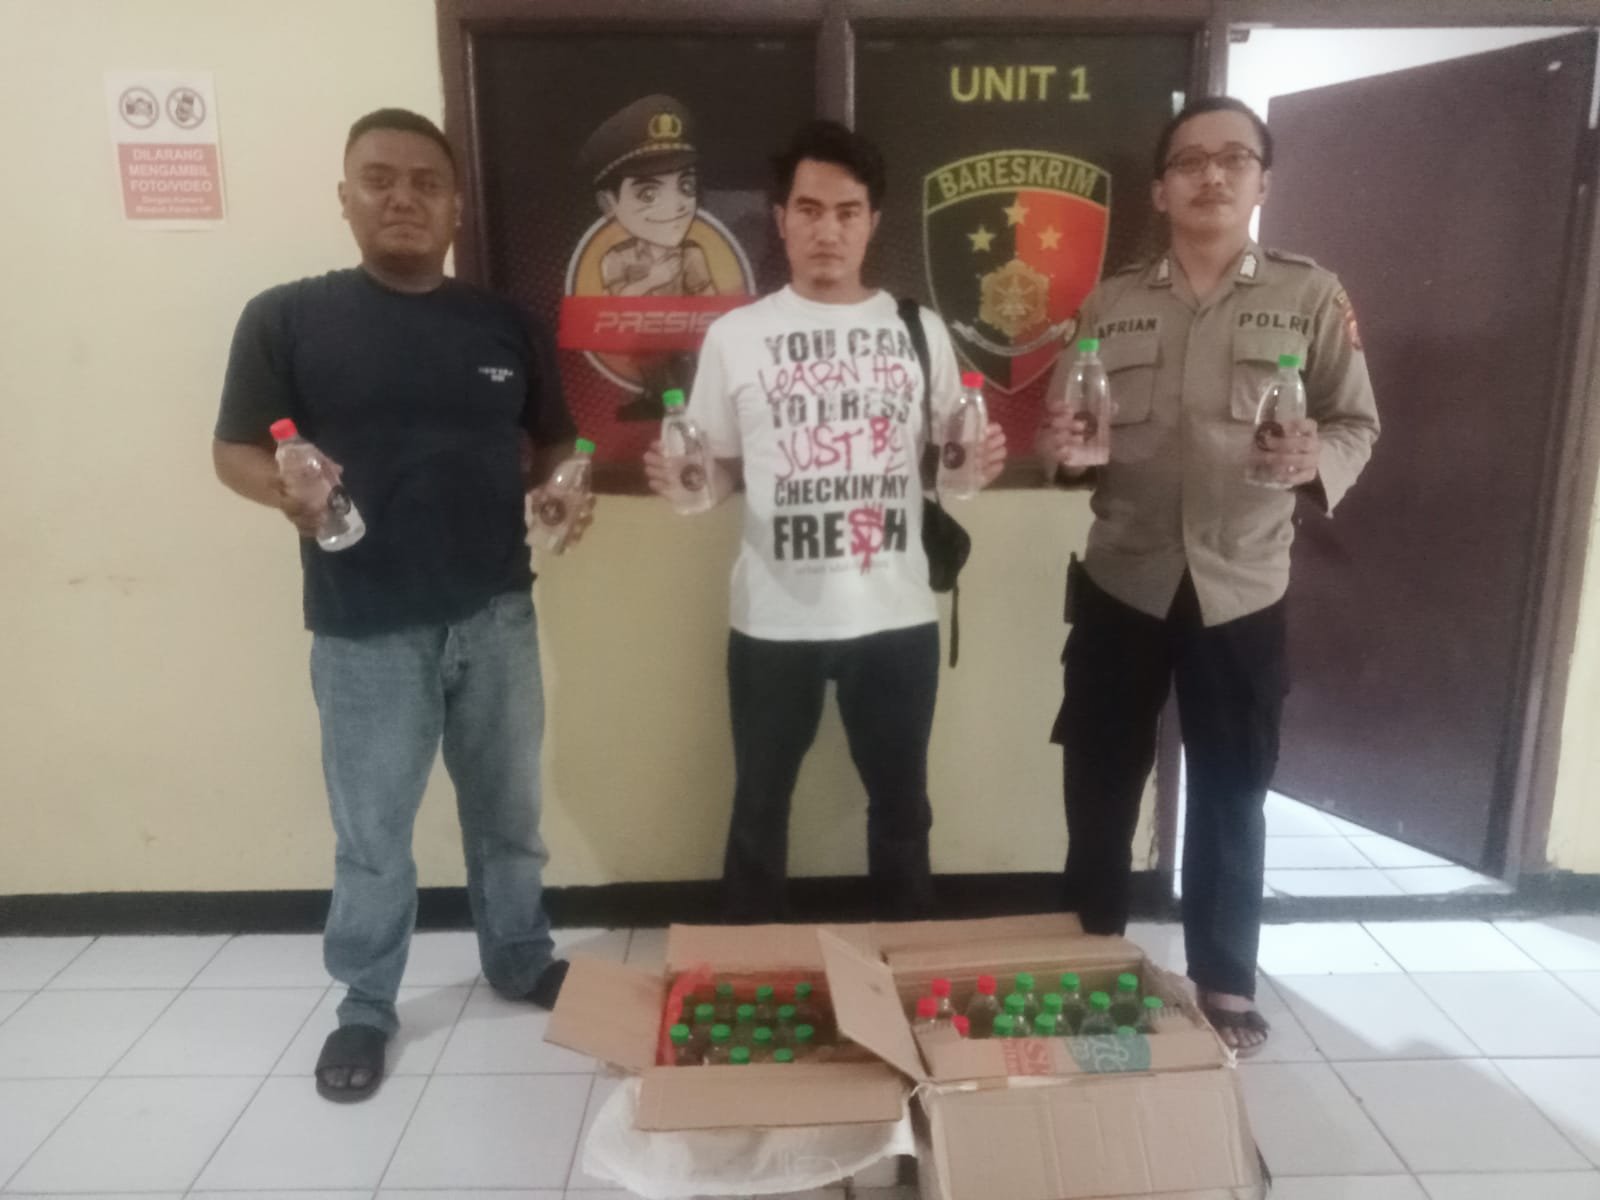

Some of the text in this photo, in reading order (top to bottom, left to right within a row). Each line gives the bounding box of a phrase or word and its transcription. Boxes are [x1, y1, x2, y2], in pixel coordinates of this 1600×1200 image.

[951, 65, 1091, 102] UNIT 1
[128, 163, 211, 177] MENGAMBIL
[132, 148, 204, 161] DILARANG
[937, 156, 1098, 200] BARESKRIM
[1239, 312, 1310, 336] POLRI
[765, 328, 915, 365] YOU CAN
[767, 394, 807, 428] TO
[775, 422, 864, 481] JUST
[881, 474, 909, 500] MY
